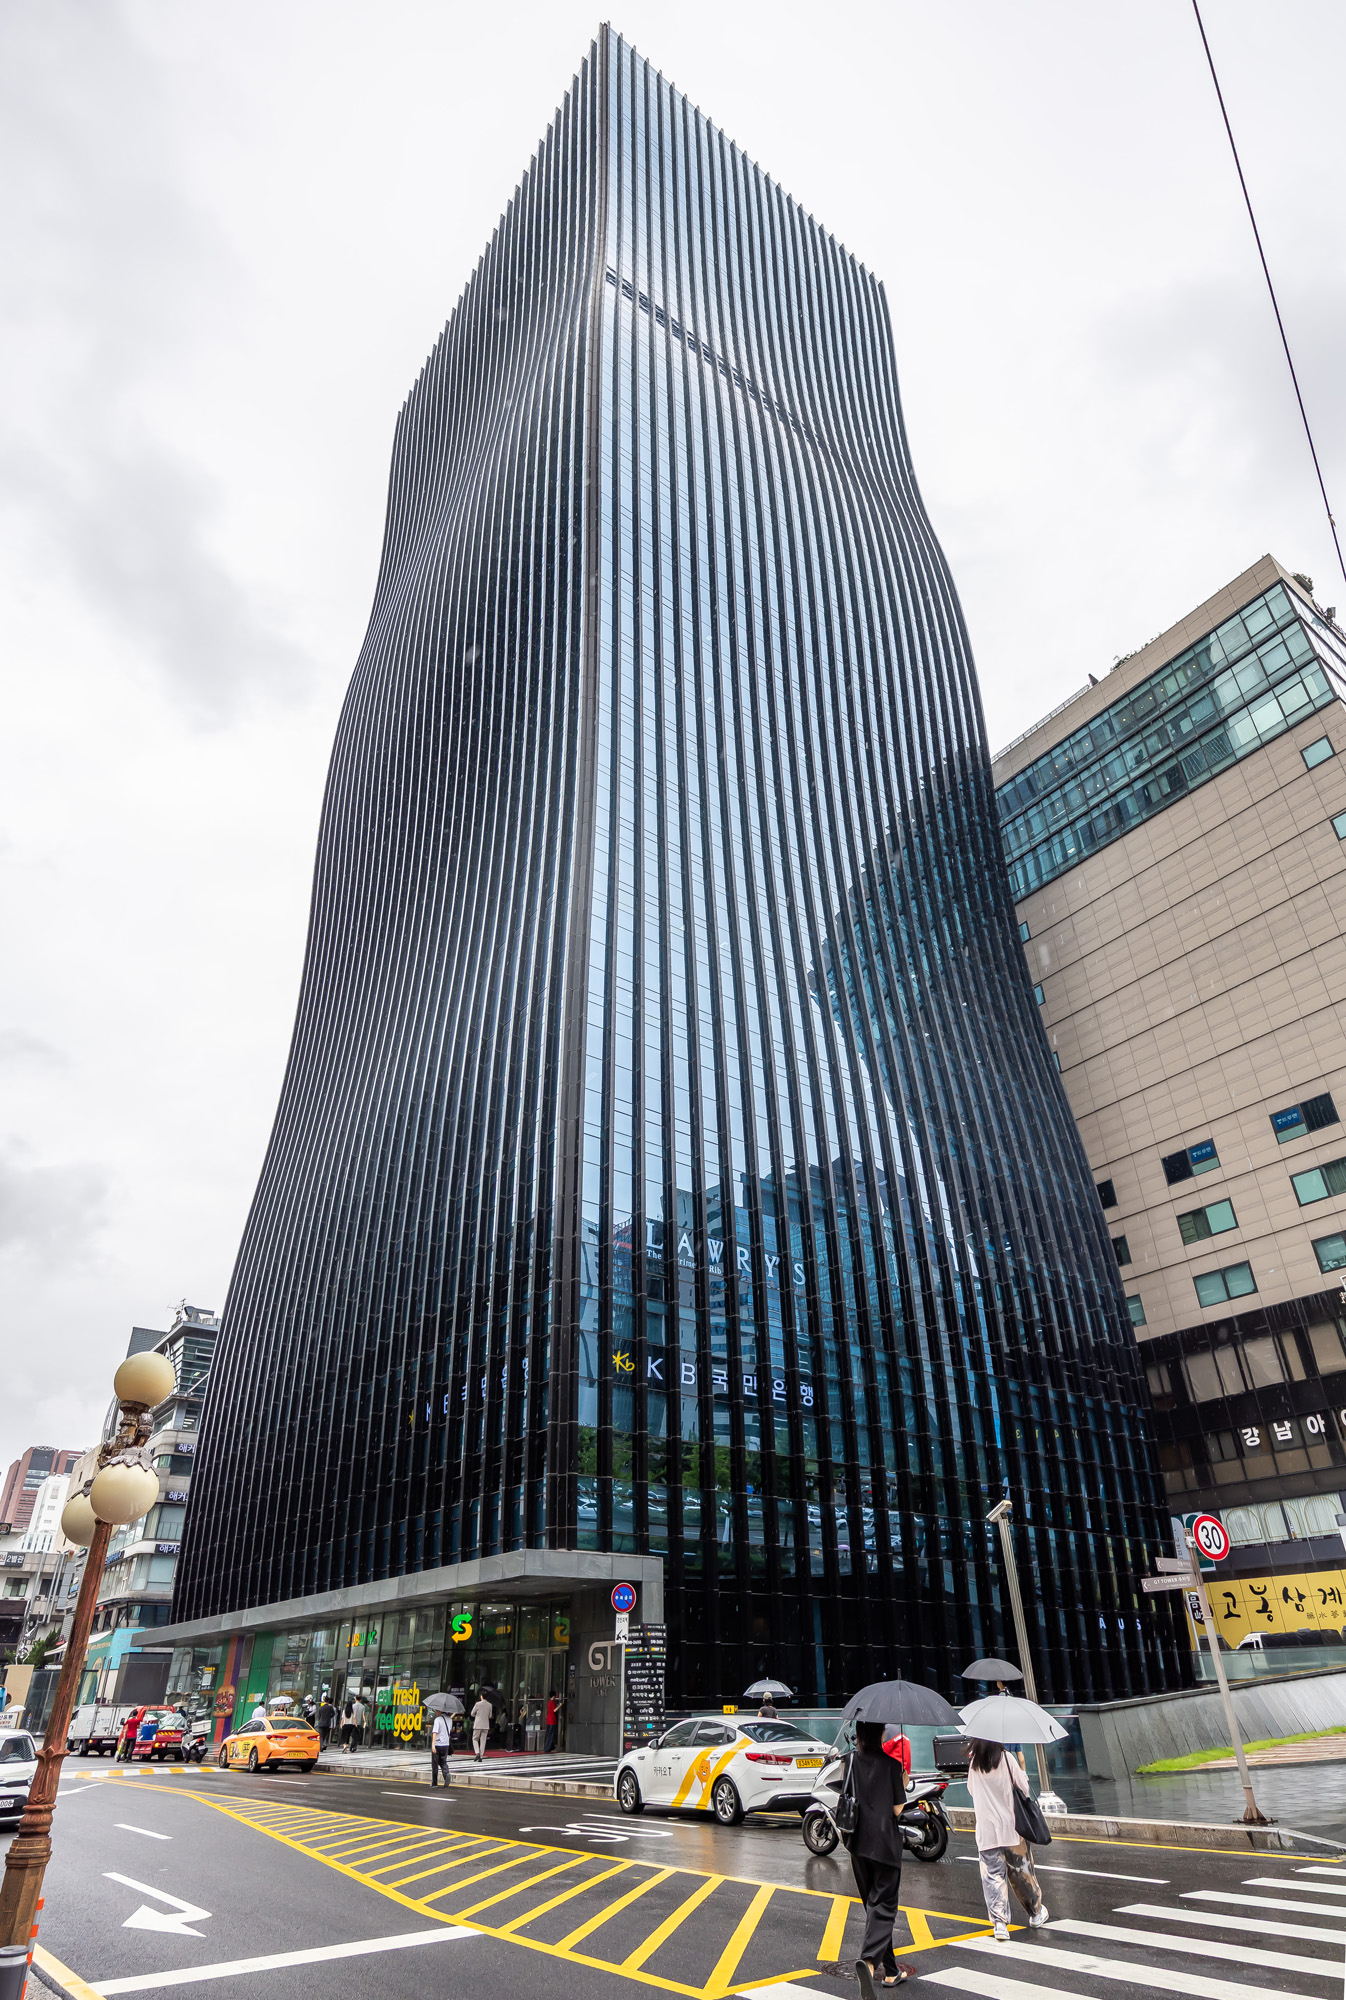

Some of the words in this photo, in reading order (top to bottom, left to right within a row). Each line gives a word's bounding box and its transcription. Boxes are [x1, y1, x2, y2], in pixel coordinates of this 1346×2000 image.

[646, 1221, 806, 1285] LAWRY'S
[646, 1249, 662, 1260] The
[678, 1257, 697, 1269] rime
[709, 1264, 722, 1275] Rib
[168, 1491, 188, 1501] 해커
[1201, 1525, 1222, 1550] 30
[590, 1674, 616, 1688] TOWER
[377, 1686, 394, 1706] eat
[393, 1682, 420, 1706] fresh
[376, 1706, 395, 1730] feel
[393, 1706, 423, 1737] good
[518, 1822, 674, 1843] 30
